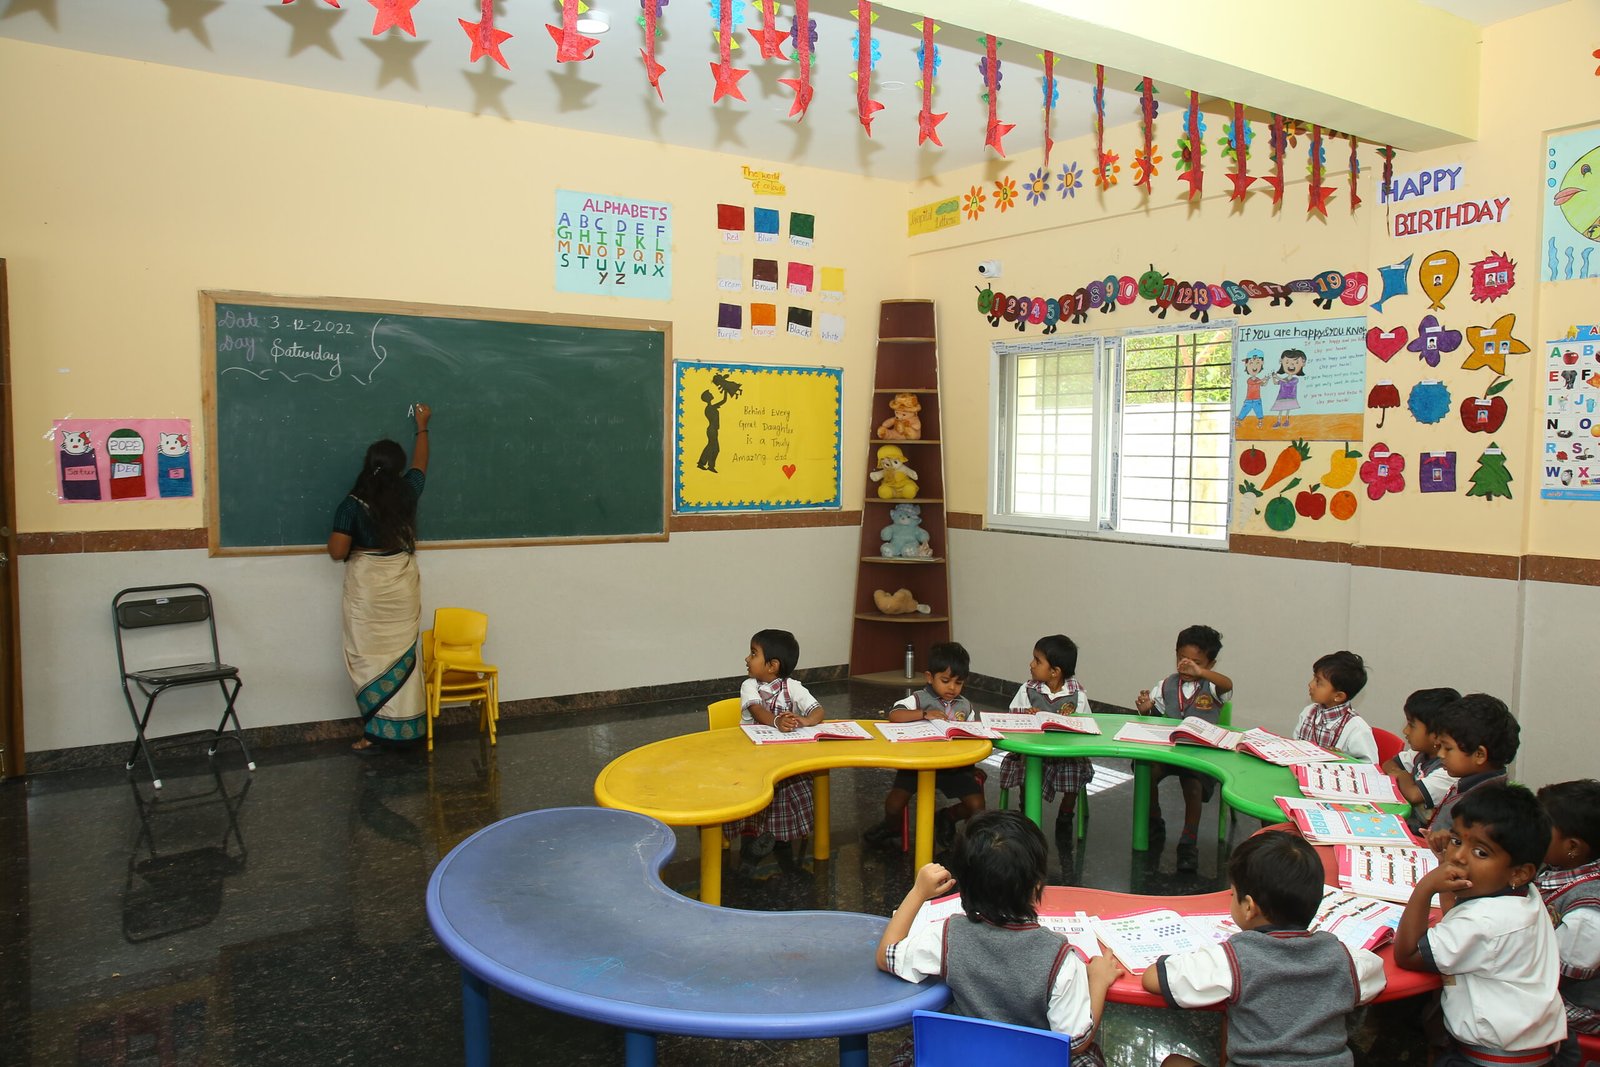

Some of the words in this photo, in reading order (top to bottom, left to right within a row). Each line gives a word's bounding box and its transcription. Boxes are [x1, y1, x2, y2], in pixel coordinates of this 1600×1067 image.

[971, 196, 978, 208] A
[1002, 188, 1008, 201] B
[1032, 179, 1041, 193] C
[1065, 172, 1074, 186] D
[1381, 166, 1462, 204] HAPPY
[582, 198, 668, 221] ALPHABETS
[1395, 197, 1511, 237] BIRTHDAY
[558, 212, 571, 226] A
[580, 214, 589, 228] B
[595, 217, 603, 230] C
[617, 220, 627, 232] D
[636, 223, 644, 235] E
[656, 225, 665, 237] F
[557, 226, 572, 240] G
[579, 229, 590, 243] H
[597, 231, 607, 245] I
[615, 233, 625, 247] J
[636, 236, 646, 249] K
[655, 238, 664, 252] L
[726, 232, 739, 241] Red
[757, 233, 773, 242] Blue
[791, 237, 810, 247] Green
[558, 240, 570, 253] M
[578, 243, 591, 256] N
[597, 245, 607, 257] O
[617, 247, 625, 259] P
[633, 250, 643, 262] Q
[655, 252, 664, 264] R
[561, 253, 569, 267] S
[577, 256, 589, 269] T
[596, 259, 606, 271] U
[615, 261, 625, 273] V
[633, 263, 646, 275] W
[652, 265, 664, 277] X
[599, 272, 608, 285] Y
[615, 273, 625, 284] Z
[754, 281, 777, 292] Brown
[1160, 284, 1175, 301] 11
[1176, 287, 1193, 304] 12
[1193, 288, 1209, 305] 13
[1226, 285, 1246, 301] 15
[1241, 283, 1262, 297] 16
[1263, 285, 1283, 294] 17
[1315, 273, 1342, 292] 19
[1343, 278, 1368, 302] 20
[994, 297, 1000, 311] 1
[1007, 299, 1016, 314] 2
[1020, 302, 1028, 316] 3
[1031, 304, 1040, 318] 4
[1047, 303, 1055, 319] 5
[1063, 299, 1070, 315] 6
[1075, 294, 1083, 311] 7
[1090, 286, 1100, 303] 8
[1106, 281, 1114, 296] 9
[1118, 280, 1134, 297] 10
[1240, 328, 1251, 342] If
[1274, 329, 1290, 337] are
[270, 338, 342, 377] Saturday
[1550, 347, 1561, 358] A
[1583, 345, 1594, 356] B
[1549, 371, 1559, 382] E
[1581, 369, 1591, 380] F
[1548, 395, 1553, 406] I
[1574, 394, 1584, 405] J
[407, 404, 414, 417] A
[743, 405, 766, 415] Behind
[771, 408, 790, 422] Every
[1547, 418, 1558, 430] N
[1579, 418, 1591, 430] O
[110, 440, 141, 451] 2022
[746, 434, 753, 445] is
[1546, 442, 1556, 453] R
[1572, 442, 1582, 454] S
[732, 453, 766, 466] Amazing
[117, 463, 137, 473] DEC
[1545, 467, 1560, 477] W
[1578, 467, 1589, 478] X
